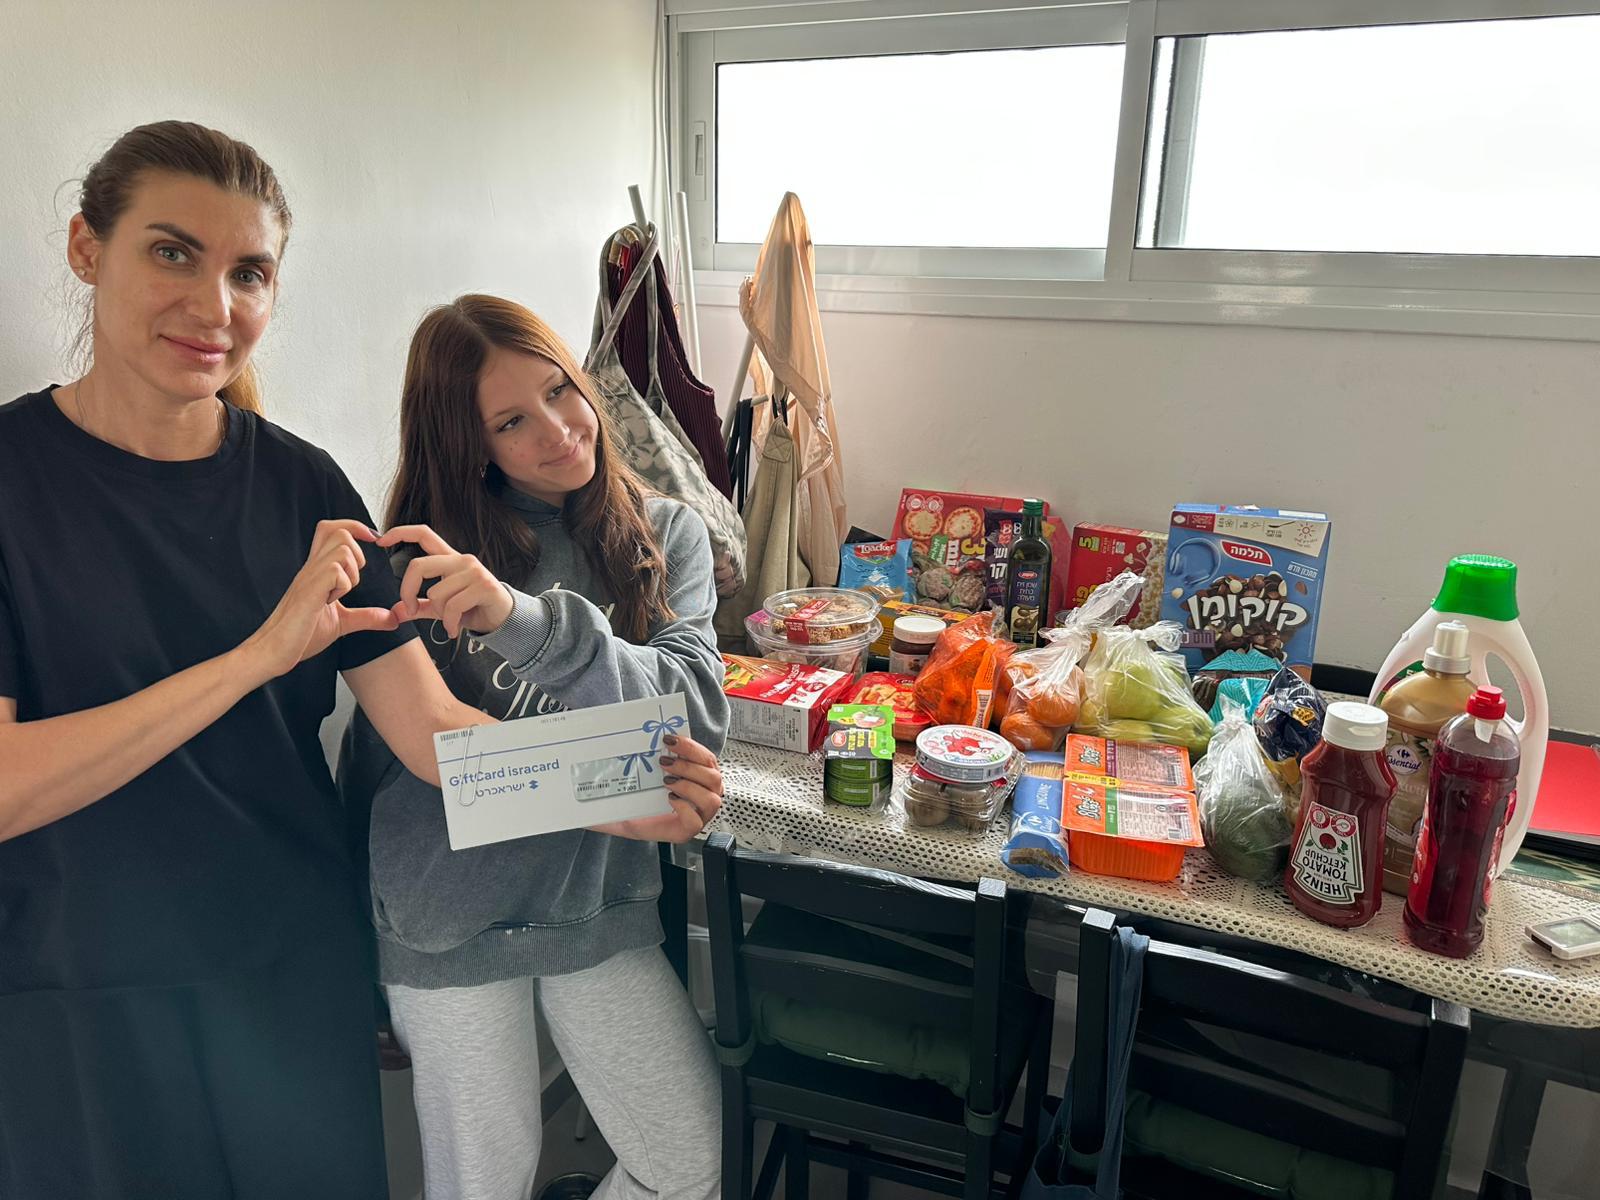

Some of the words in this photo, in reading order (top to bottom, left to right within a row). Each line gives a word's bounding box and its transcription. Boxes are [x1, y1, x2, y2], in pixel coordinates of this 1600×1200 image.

[861, 541, 895, 554] Loacker
[1230, 545, 1264, 559] תלמה
[1386, 754, 1422, 770] Essential
[449, 767, 505, 787] GiftCard
[508, 758, 560, 777] isracard
[475, 782, 525, 798] ישראכרט
[1305, 849, 1346, 870] KETCHUP
[1302, 856, 1347, 882] TOMATO
[1302, 872, 1342, 896] HEINZ
